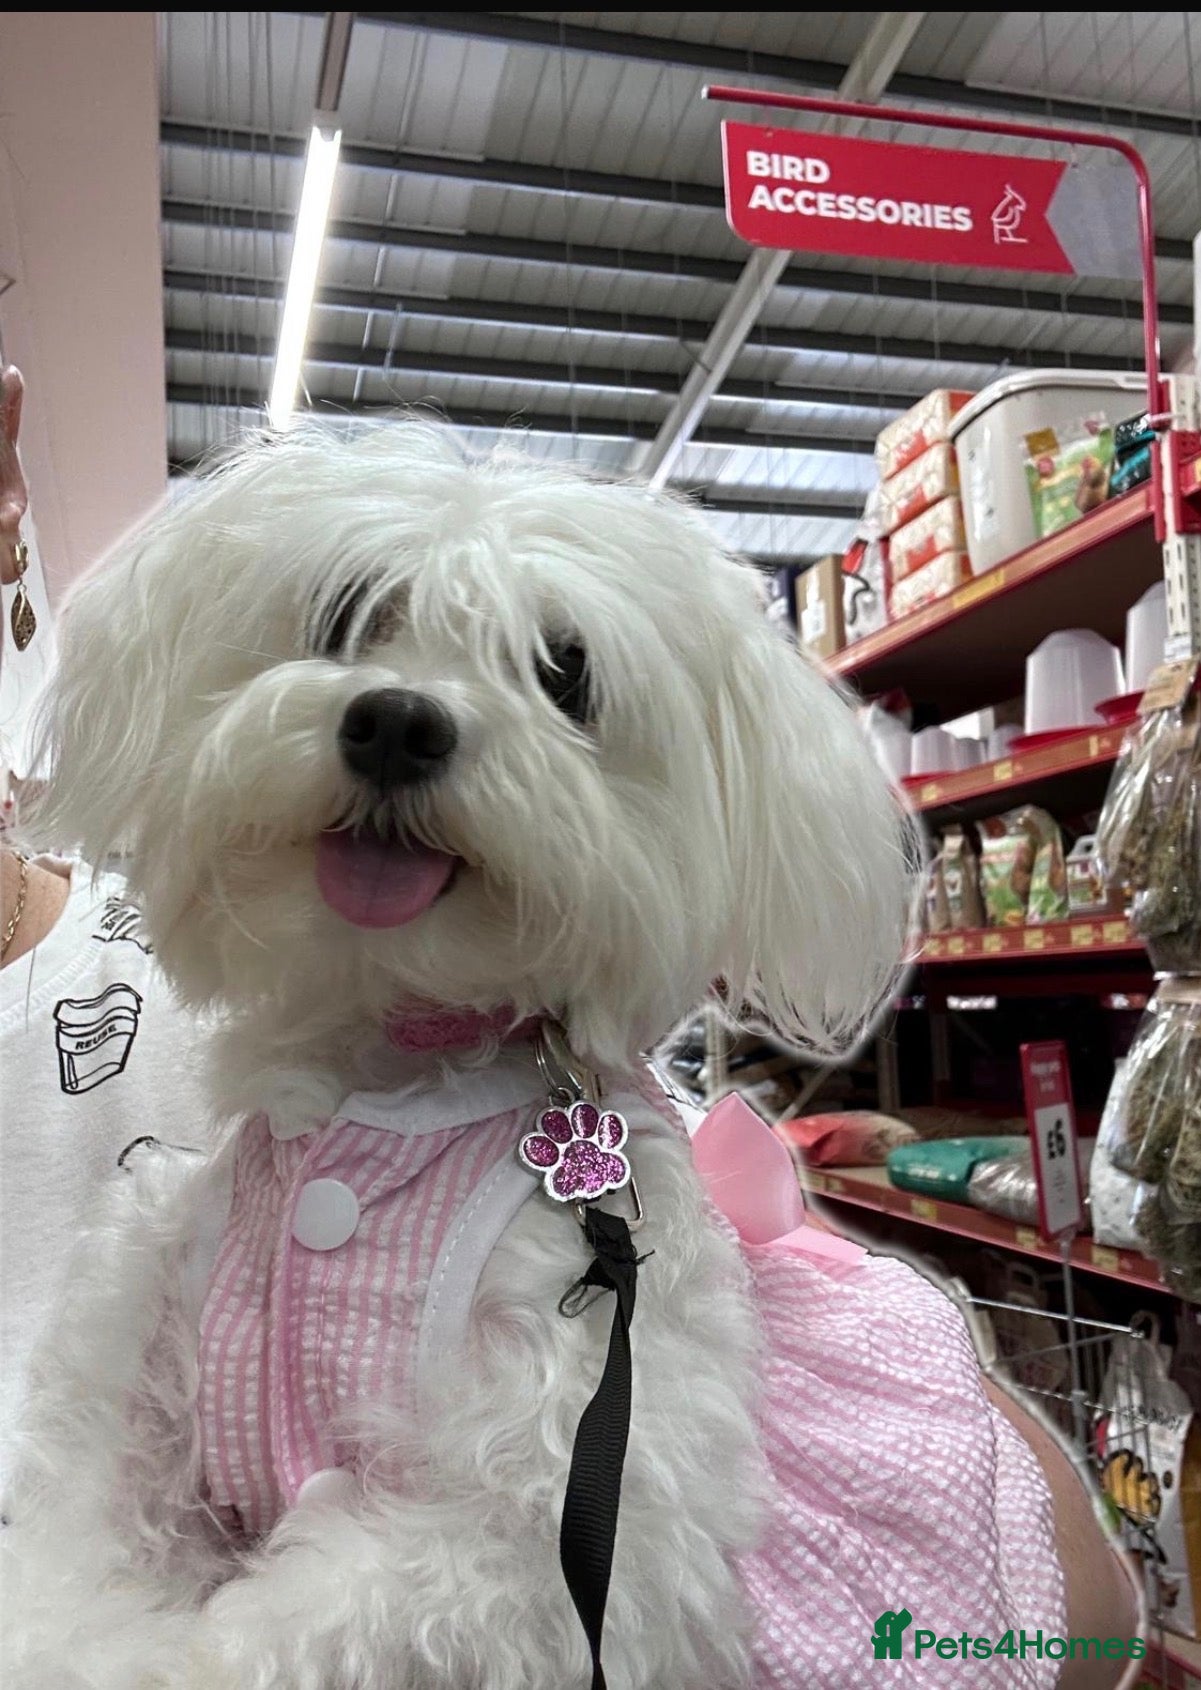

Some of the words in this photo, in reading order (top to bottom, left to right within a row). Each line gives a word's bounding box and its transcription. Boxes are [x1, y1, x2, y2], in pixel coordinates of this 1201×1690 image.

[746, 150, 830, 184] BIRD
[747, 185, 973, 233] ACCESSORIES
[75, 1024, 117, 1050] REUSE
